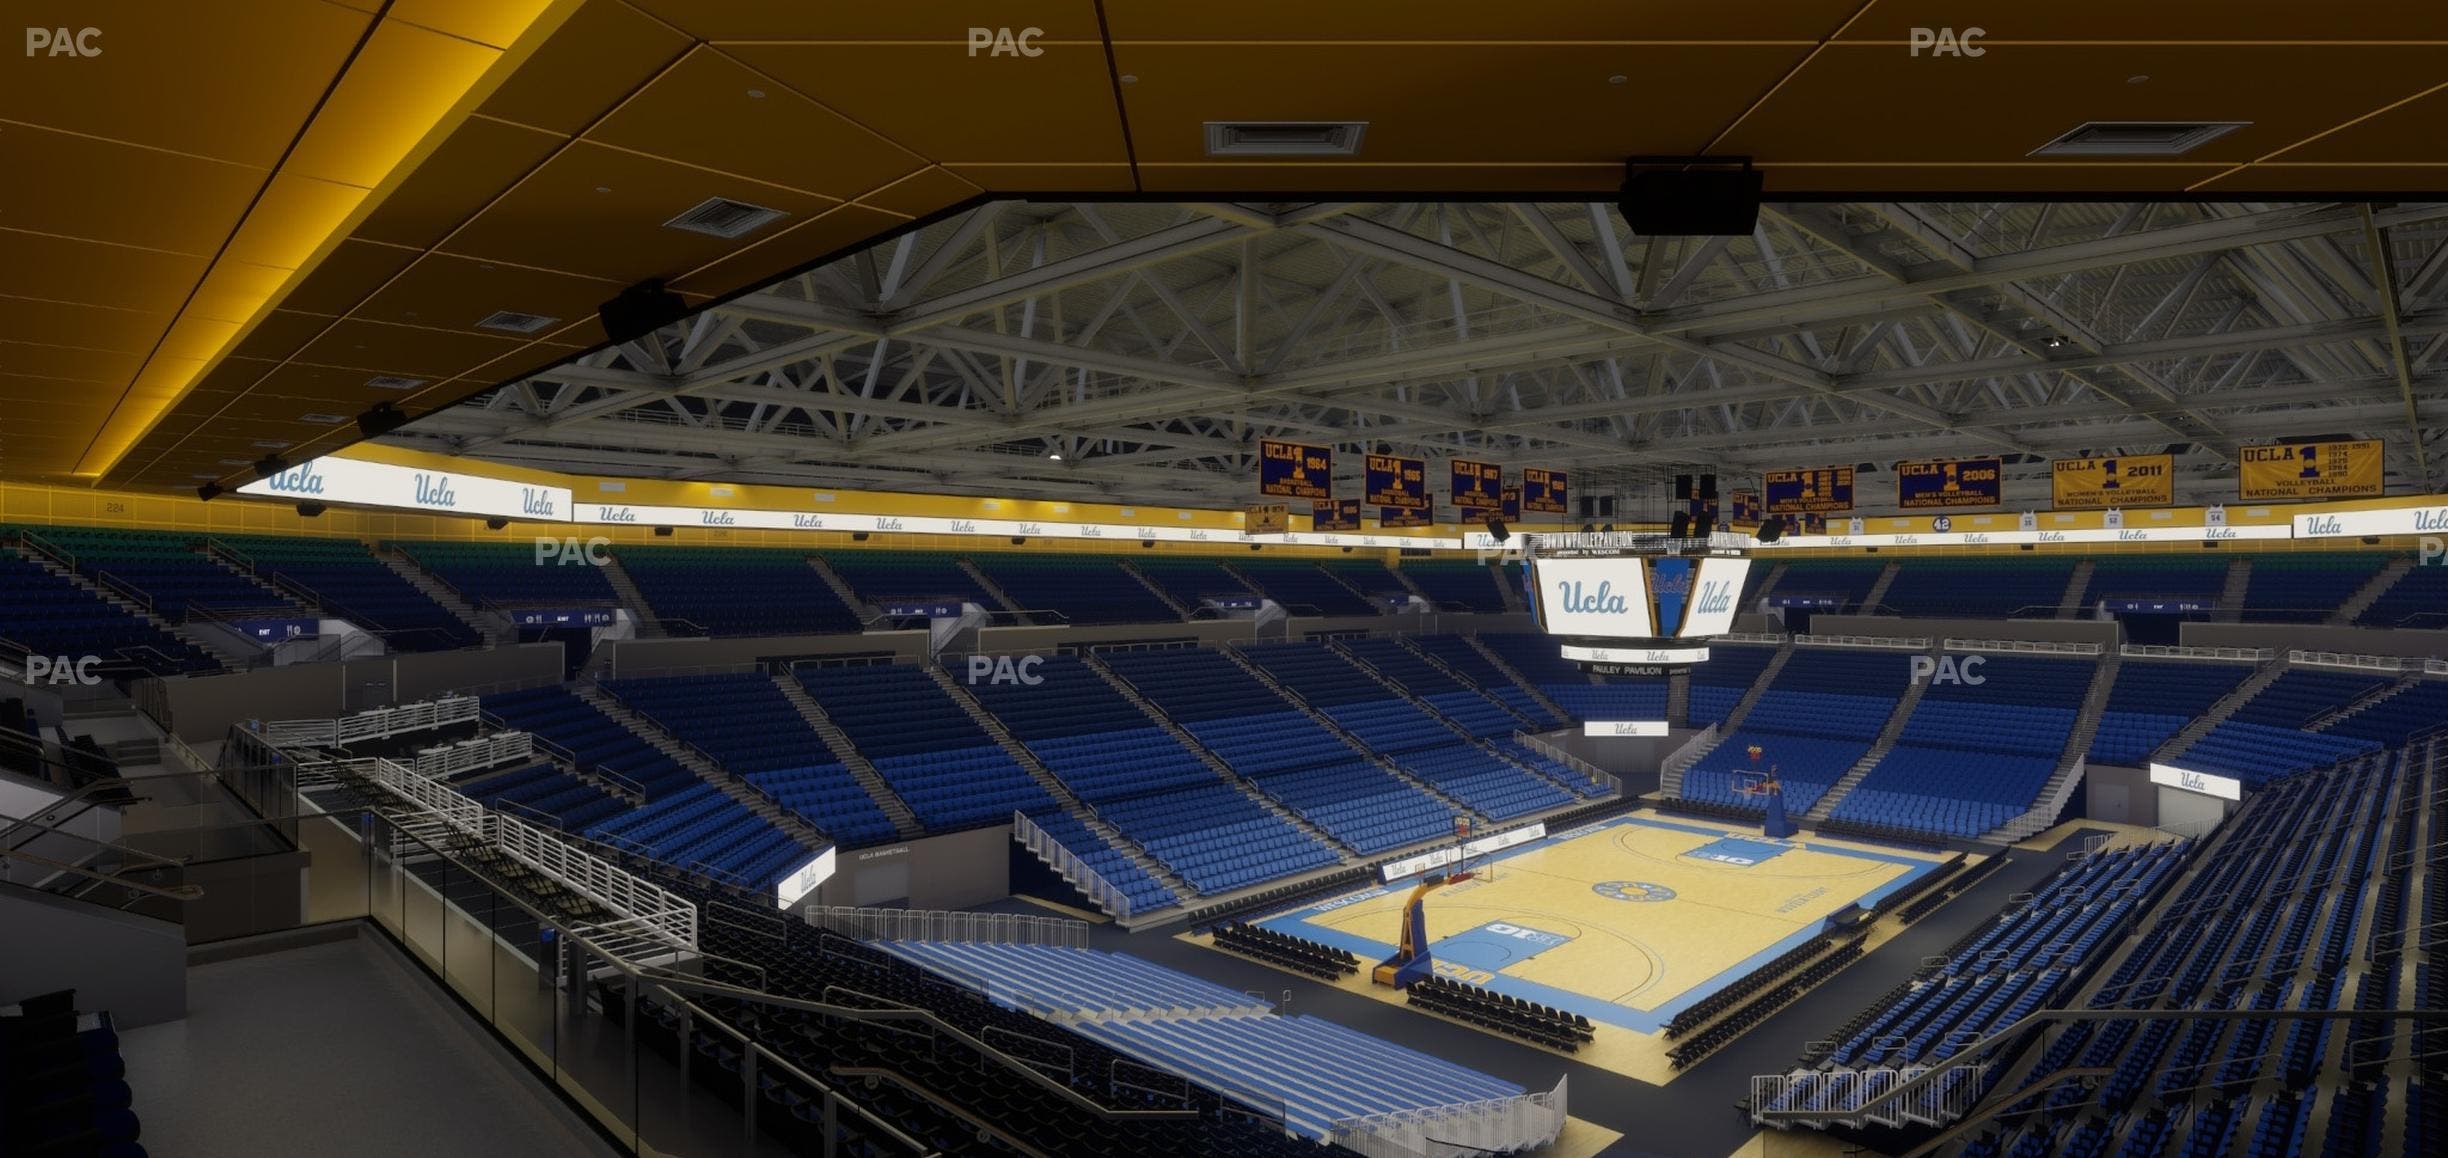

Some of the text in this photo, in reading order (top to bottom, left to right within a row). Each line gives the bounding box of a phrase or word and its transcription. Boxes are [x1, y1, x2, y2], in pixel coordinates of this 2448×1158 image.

[1265, 443, 1294, 460] UCLA
[1307, 456, 1327, 470] 1964
[2244, 448, 2294, 462] UCLA
[1370, 457, 1393, 472] UCLA
[2056, 461, 2096, 472] UCLA
[2127, 464, 2162, 477] 2011
[1767, 473, 1798, 483] UCLA
[1902, 464, 1938, 476] UCLA
[1963, 469, 1995, 481] 2006
[2275, 479, 2335, 487] VOLLEYBALL
[414, 473, 456, 507] Ucla
[2246, 484, 2376, 497] NATIONAL CHAMPIONS
[522, 487, 554, 516] Ucla
[1770, 501, 1849, 512] NATIONAL CHAMPIONS
[1904, 496, 1995, 507] NATIONAL CHAMPIONS
[2058, 495, 2167, 506] NATIONAL CHAMPIONS
[106, 502, 124, 513] 224
[599, 506, 636, 522] Ucla
[701, 510, 736, 526] Ucla
[793, 514, 823, 528] Ucla
[876, 517, 903, 530] Ucla
[1933, 518, 1950, 531] 42
[950, 520, 976, 533] Ucla
[1018, 523, 1041, 535] Ucla
[1080, 525, 1101, 537] Ucla
[2307, 515, 2342, 535] Ucla
[1137, 527, 1156, 538] Ucla
[1190, 529, 1207, 540] Ucla
[1964, 533, 1989, 543] Ucla
[2038, 532, 2065, 542] Ucla
[2118, 529, 2147, 540] Ucla
[2206, 528, 2236, 539] Ucla
[1894, 535, 1917, 544] Ucla
[1650, 572, 1689, 593] Ucla
[1558, 580, 1628, 614] Ucla
[1697, 580, 1731, 614] Ucla
[1646, 650, 1670, 662] Ucla
[1592, 664, 1621, 673] PAULEY
[1624, 666, 1662, 675] PAVILION
[1614, 723, 1638, 735] Ucla
[2180, 771, 2205, 791] Ucla
